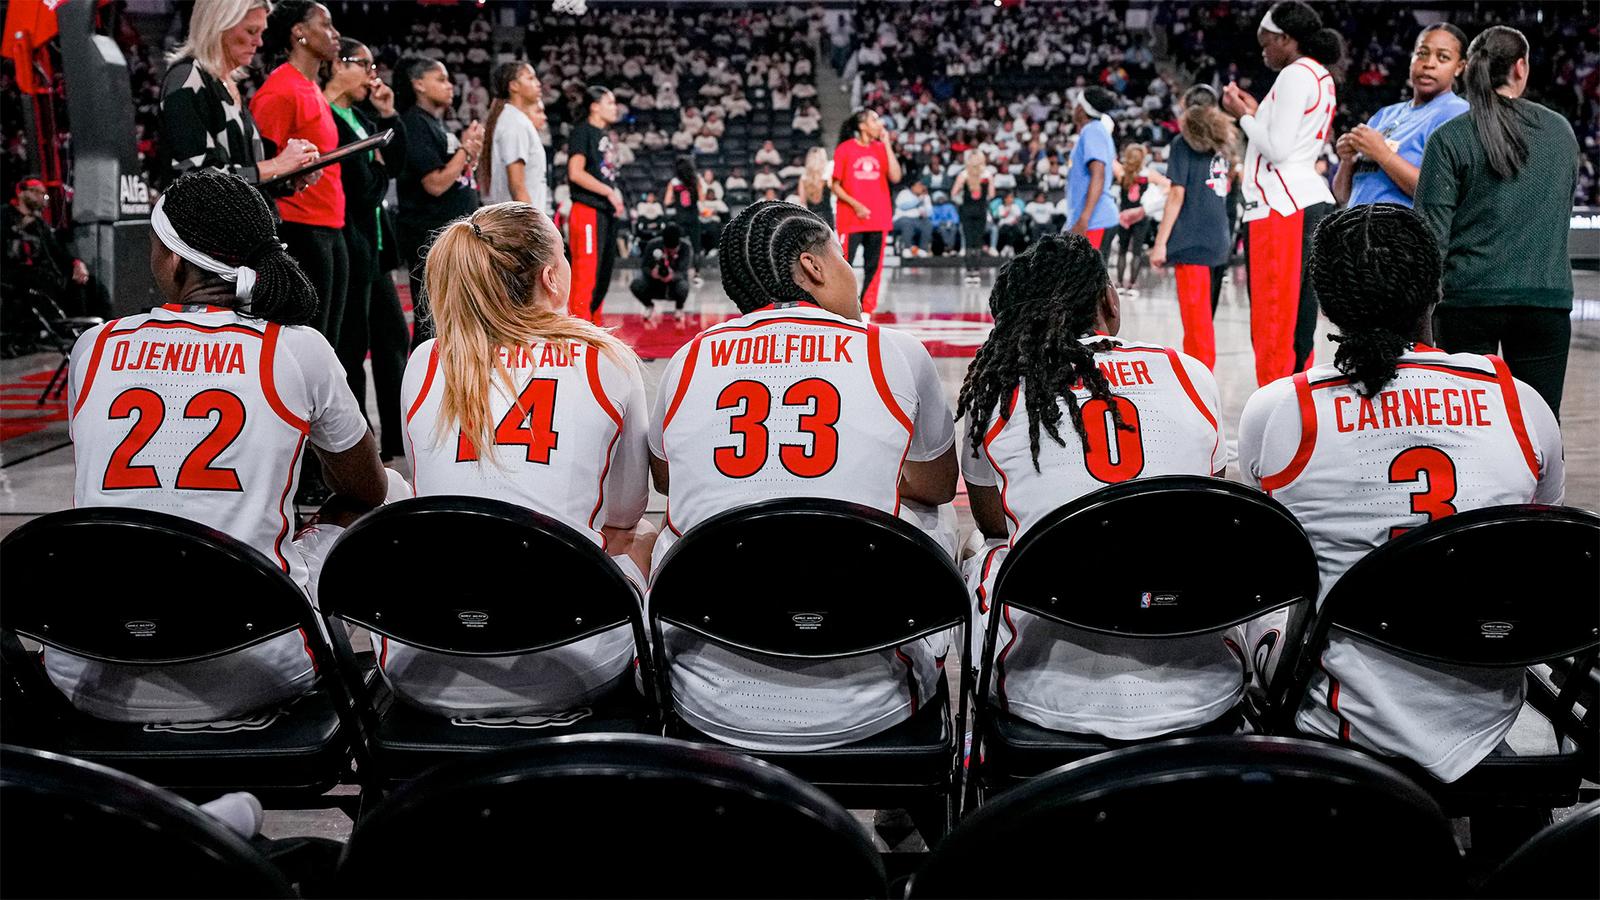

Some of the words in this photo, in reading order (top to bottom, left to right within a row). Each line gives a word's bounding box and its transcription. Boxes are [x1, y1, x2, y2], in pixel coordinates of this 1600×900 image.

[120, 174, 149, 203] Alfa
[111, 340, 246, 375] OJENUWA
[710, 334, 853, 368] WOOLFOLK
[102, 387, 244, 492] 22
[713, 377, 842, 479] 33
[1081, 394, 1145, 485] 0
[1334, 388, 1492, 433] CARNEGIE
[1387, 445, 1458, 540] 3
